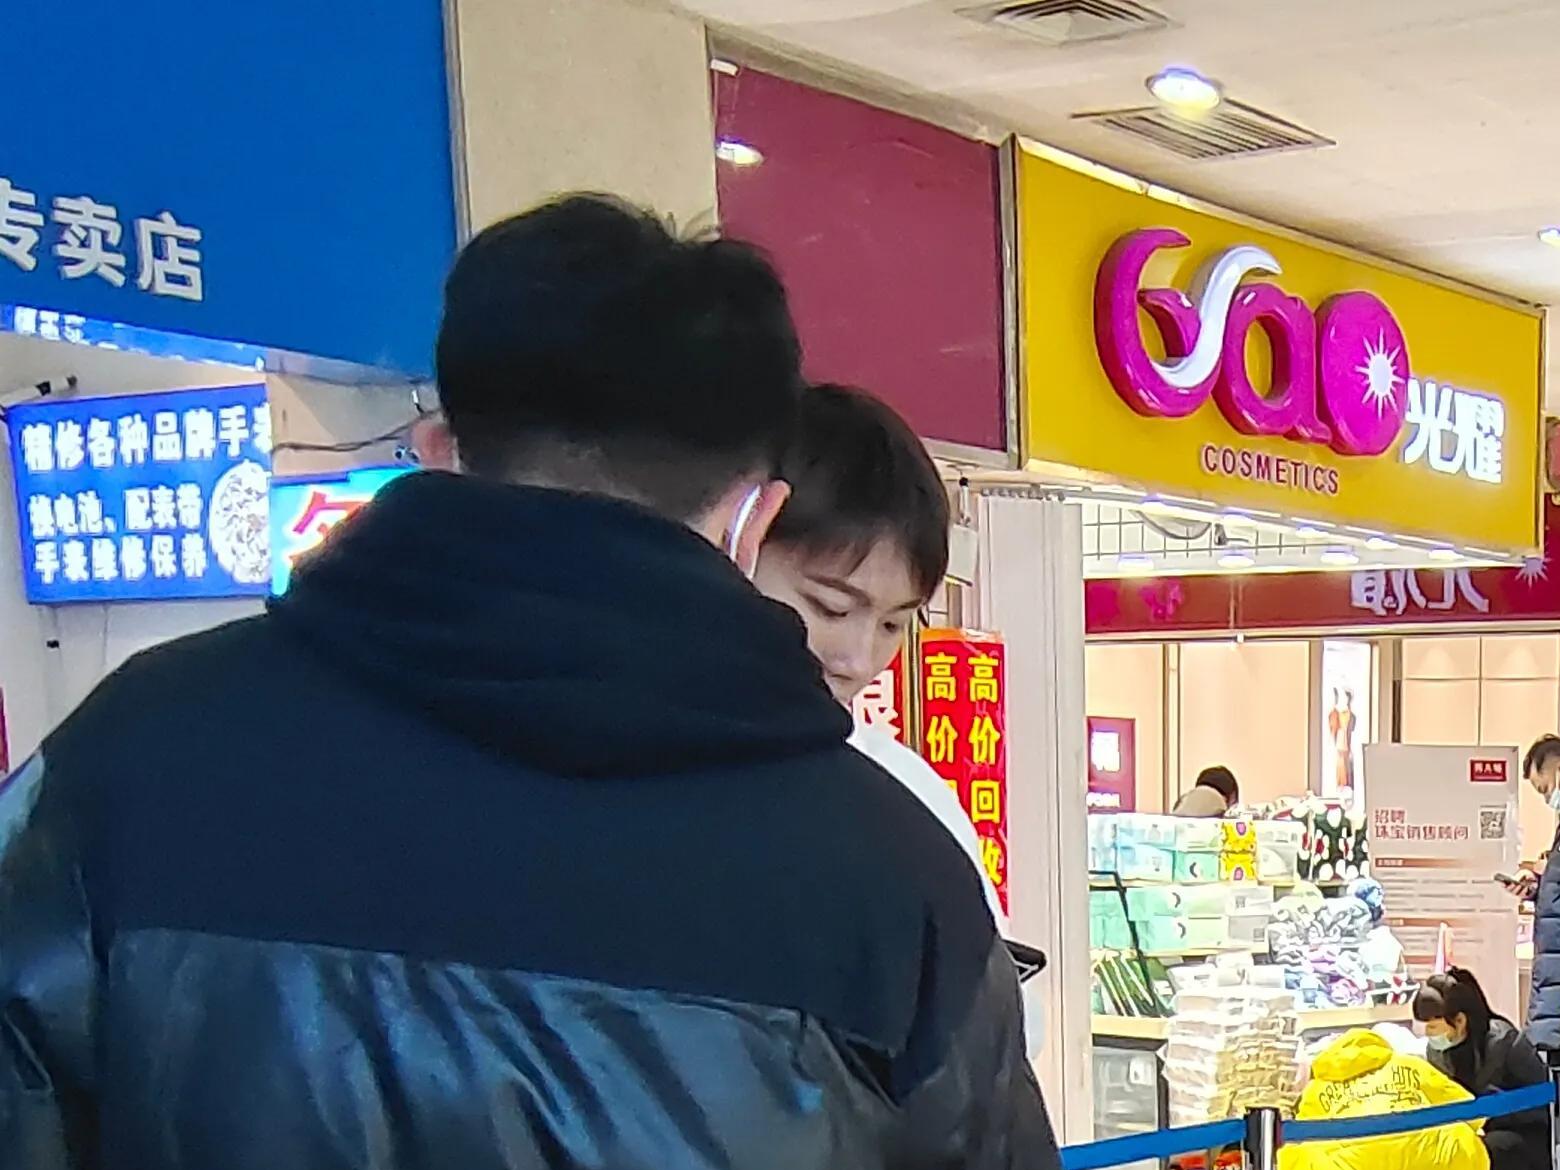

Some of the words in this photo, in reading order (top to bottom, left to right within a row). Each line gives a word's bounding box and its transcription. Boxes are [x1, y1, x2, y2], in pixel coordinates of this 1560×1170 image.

[0, 177, 203, 301] 专卖店
[1203, 444, 1340, 496] COSMETICS
[1402, 378, 1505, 483] 光耀
[968, 653, 1002, 884] 高价回收
